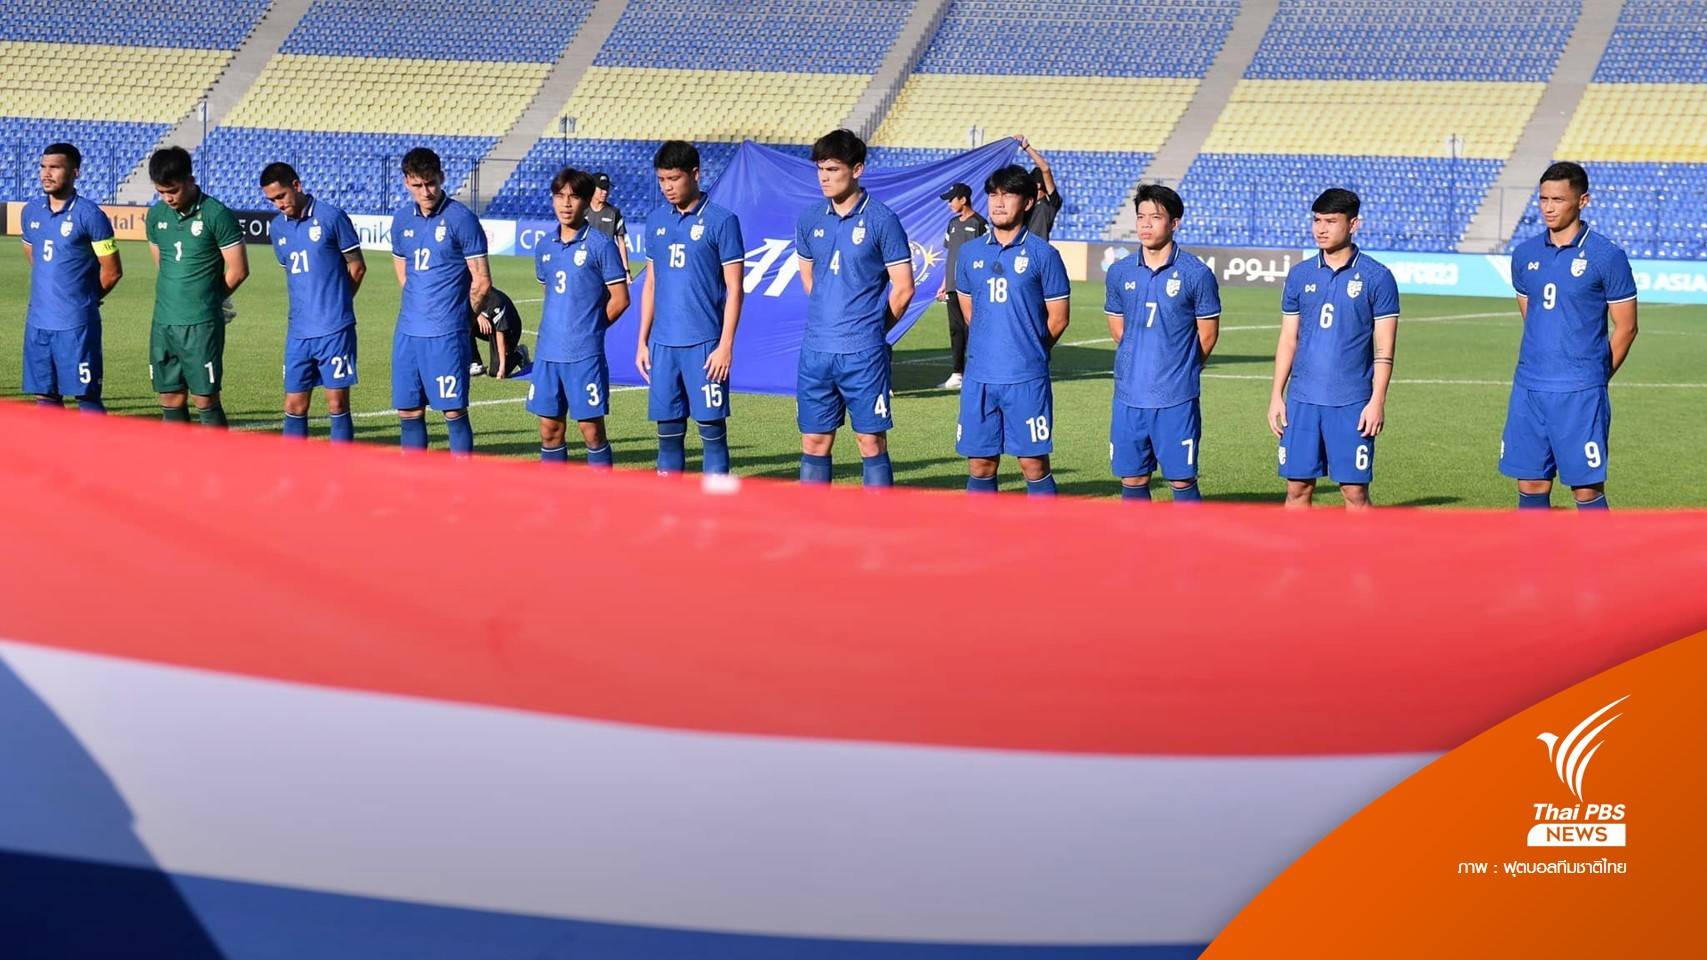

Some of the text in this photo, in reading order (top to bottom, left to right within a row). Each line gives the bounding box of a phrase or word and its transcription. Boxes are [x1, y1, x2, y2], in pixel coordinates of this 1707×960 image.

[43, 239, 54, 262] 5
[174, 240, 183, 262] 1
[289, 249, 310, 274] 21
[414, 247, 431, 271] 12
[668, 243, 686, 268] 15
[829, 250, 840, 275] 4
[1223, 255, 1290, 282] نيوم
[555, 270, 567, 294] 3
[986, 277, 1008, 303] 18
[1542, 282, 1557, 310] 9
[1145, 302, 1158, 328] 7
[1319, 303, 1335, 329] 6
[78, 362, 92, 384] 5
[204, 361, 215, 384] 1
[436, 375, 457, 399] 12
[586, 383, 600, 406] 3
[701, 383, 723, 408] 15
[874, 394, 887, 418] 4
[1025, 415, 1050, 443] 18
[1181, 439, 1194, 465] 7
[1355, 445, 1369, 471] 6
[1584, 441, 1601, 468] 9
